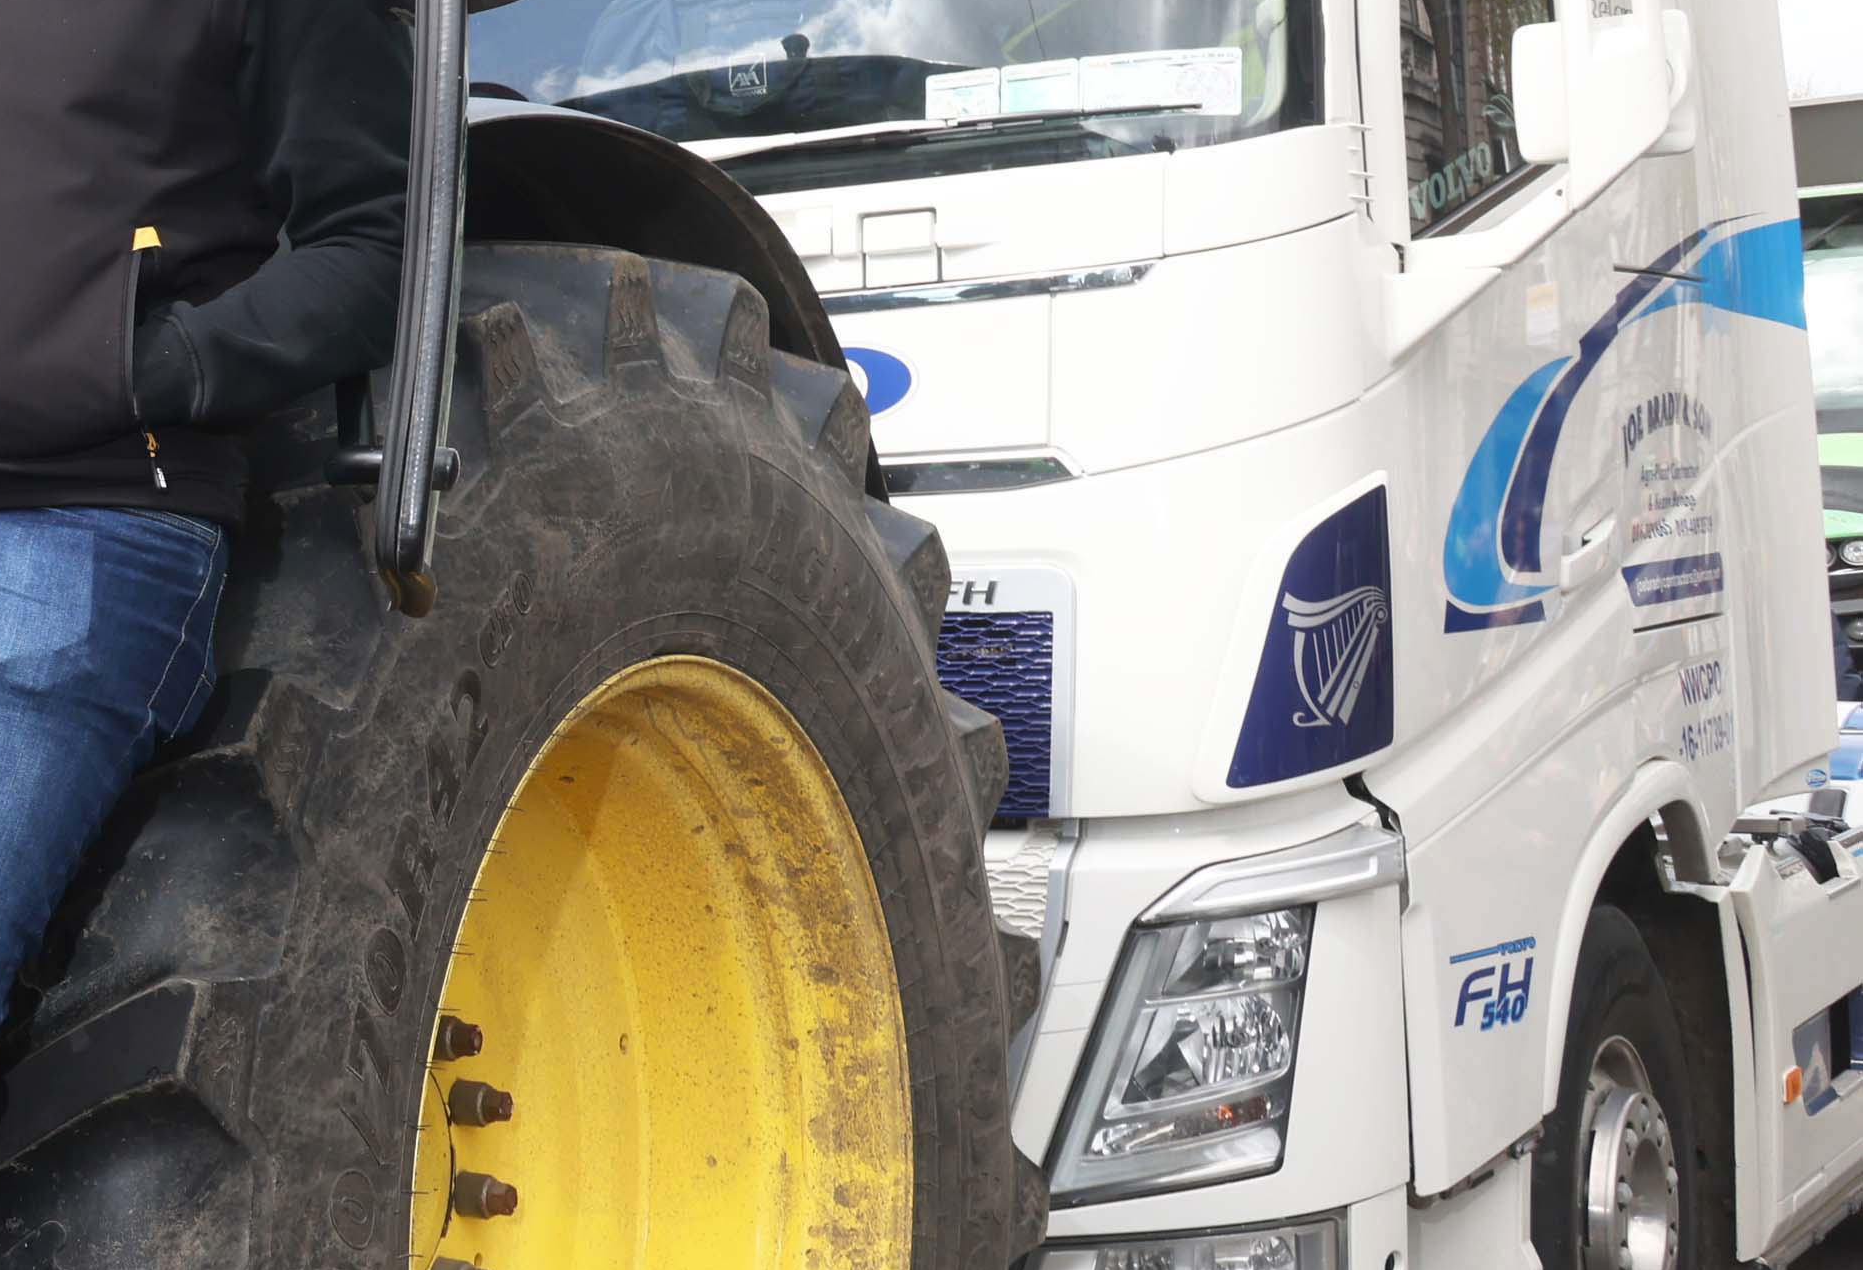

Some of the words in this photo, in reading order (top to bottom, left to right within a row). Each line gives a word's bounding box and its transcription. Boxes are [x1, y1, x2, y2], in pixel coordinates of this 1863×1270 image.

[1408, 141, 1491, 219] VOLVO
[1622, 404, 1644, 468] JOE
[1647, 391, 1682, 433] BRADY
[1678, 660, 1722, 706] NWCPO
[1454, 957, 1534, 1027] FH
[1480, 992, 1527, 1031] 540
